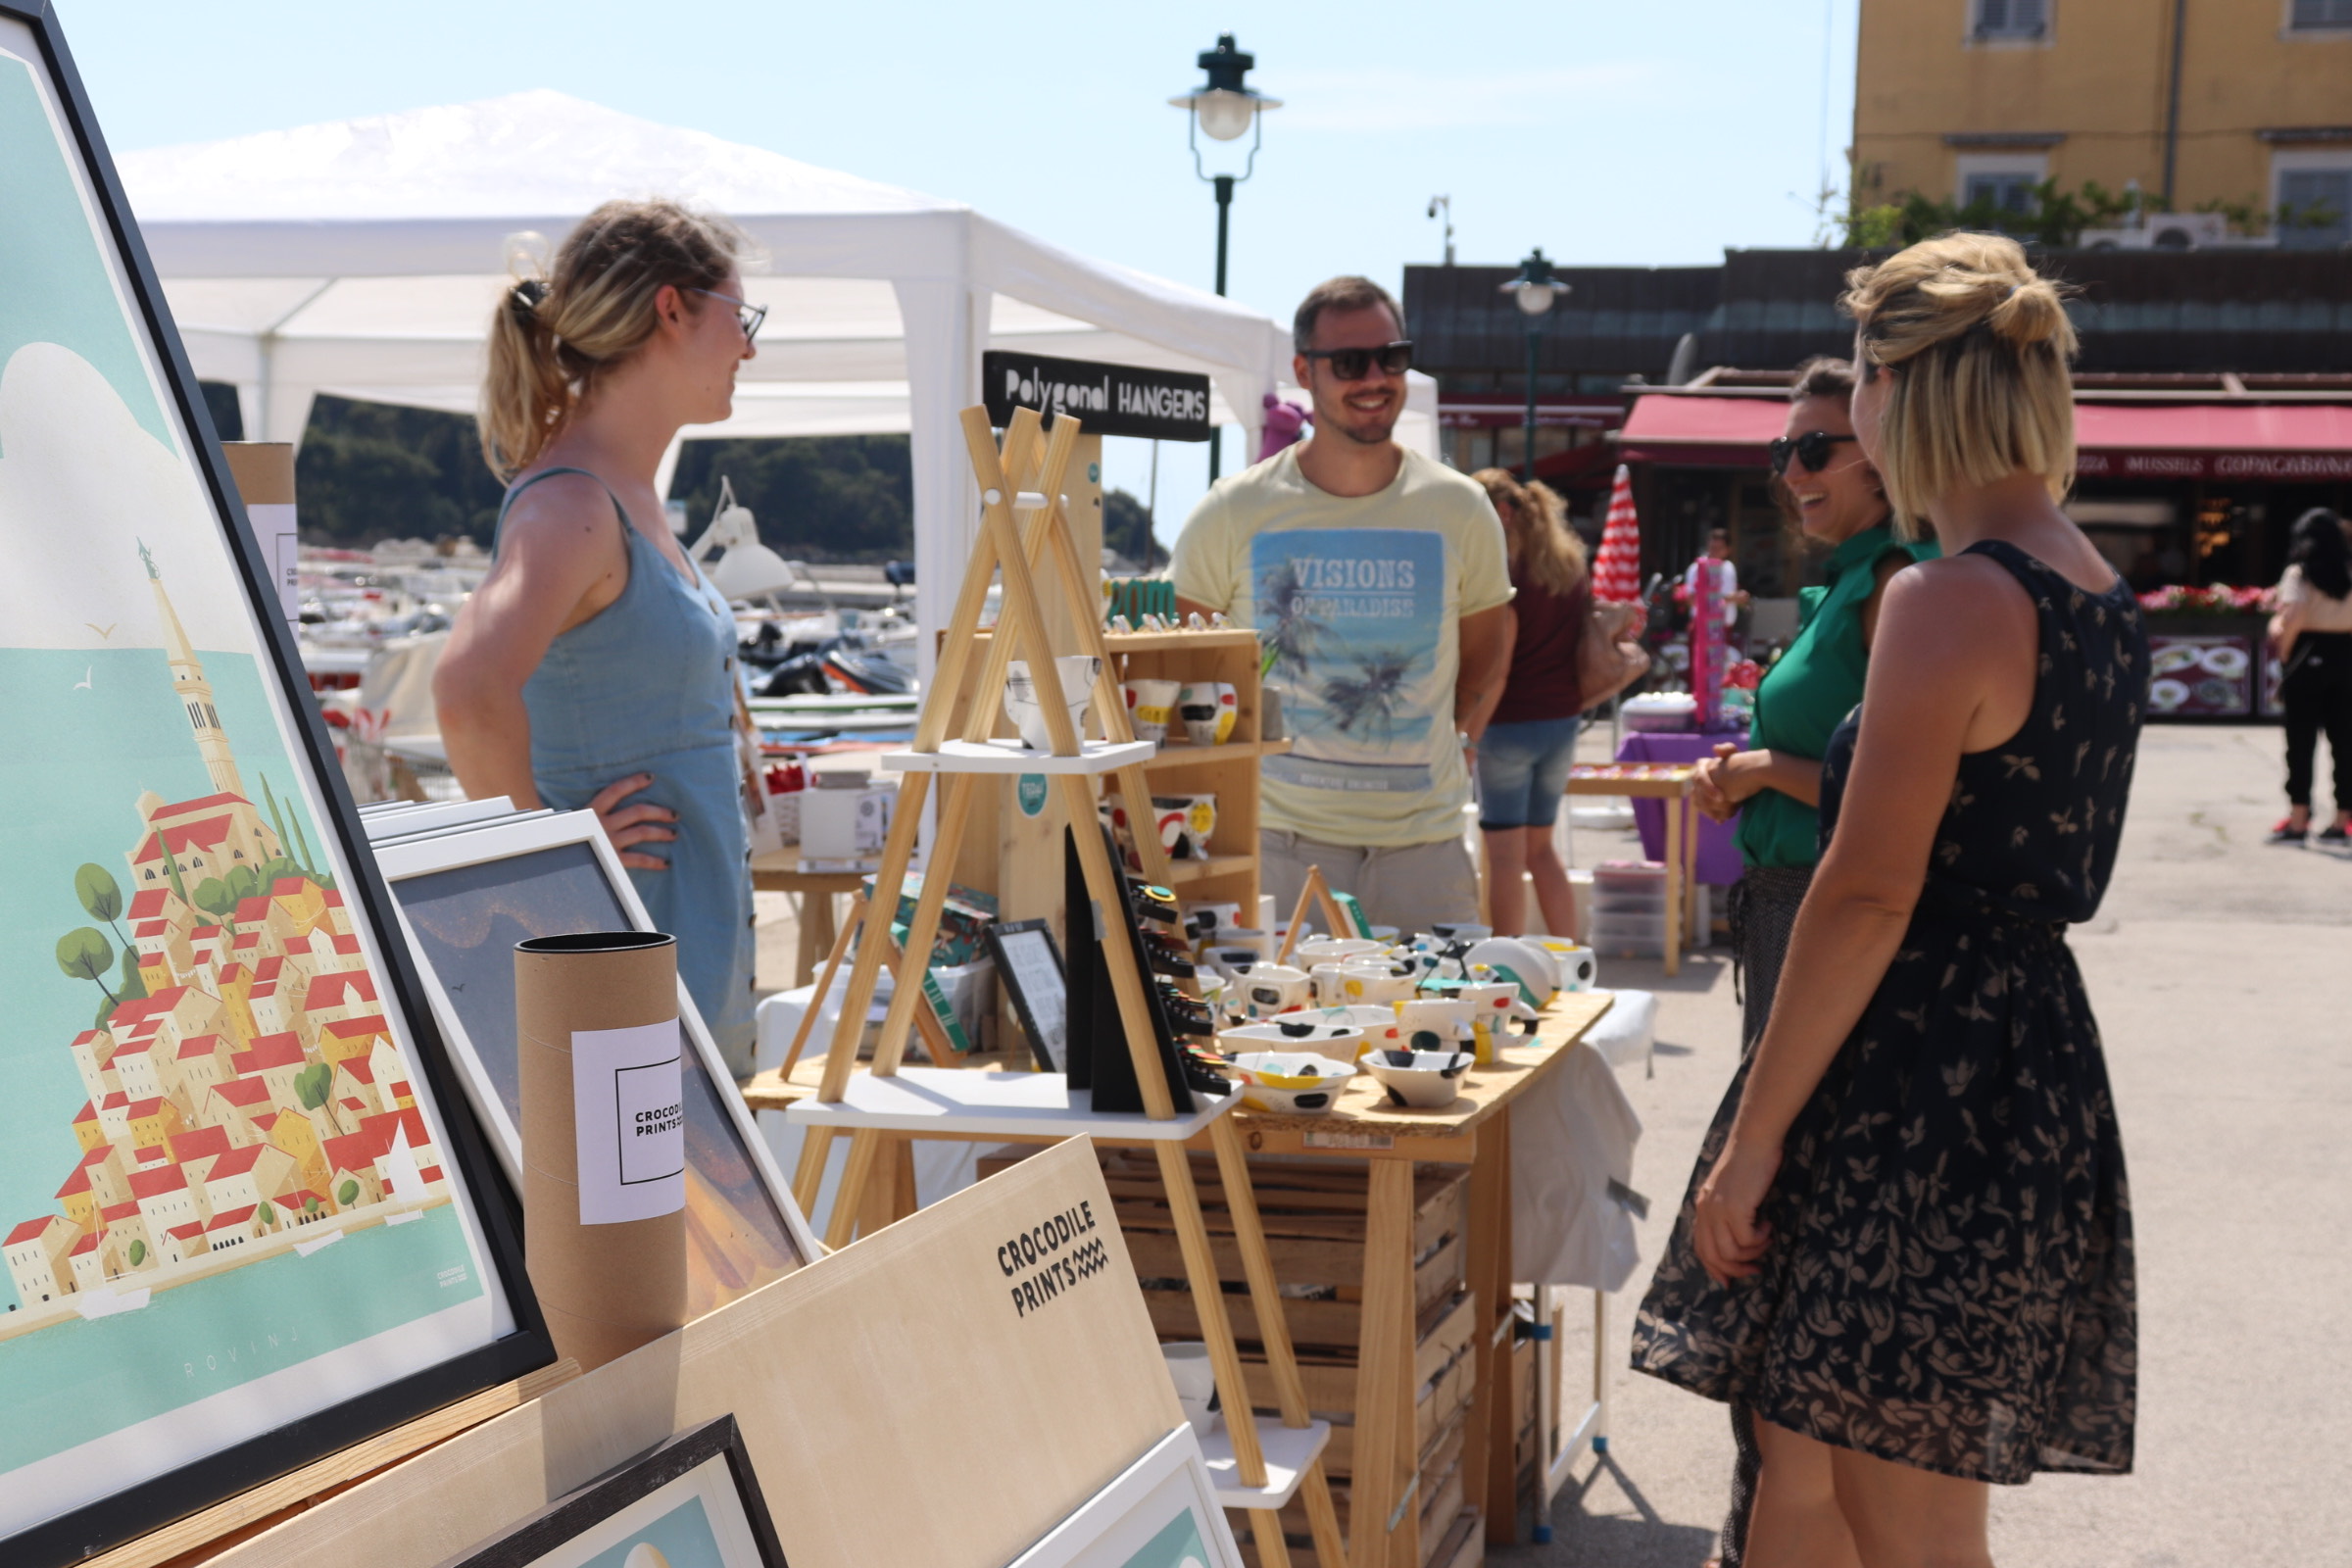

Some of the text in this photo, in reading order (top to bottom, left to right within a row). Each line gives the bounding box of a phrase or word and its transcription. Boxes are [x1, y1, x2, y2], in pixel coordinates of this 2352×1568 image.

[1005, 366, 1205, 421] Polygonal HANGERS
[2077, 455, 2109, 471] ZZA
[1290, 559, 1415, 588] VISIONS
[636, 1118, 676, 1137] PRINTS
[998, 1200, 1096, 1277] CROCODILE
[1011, 1257, 1076, 1318] PRINTS
